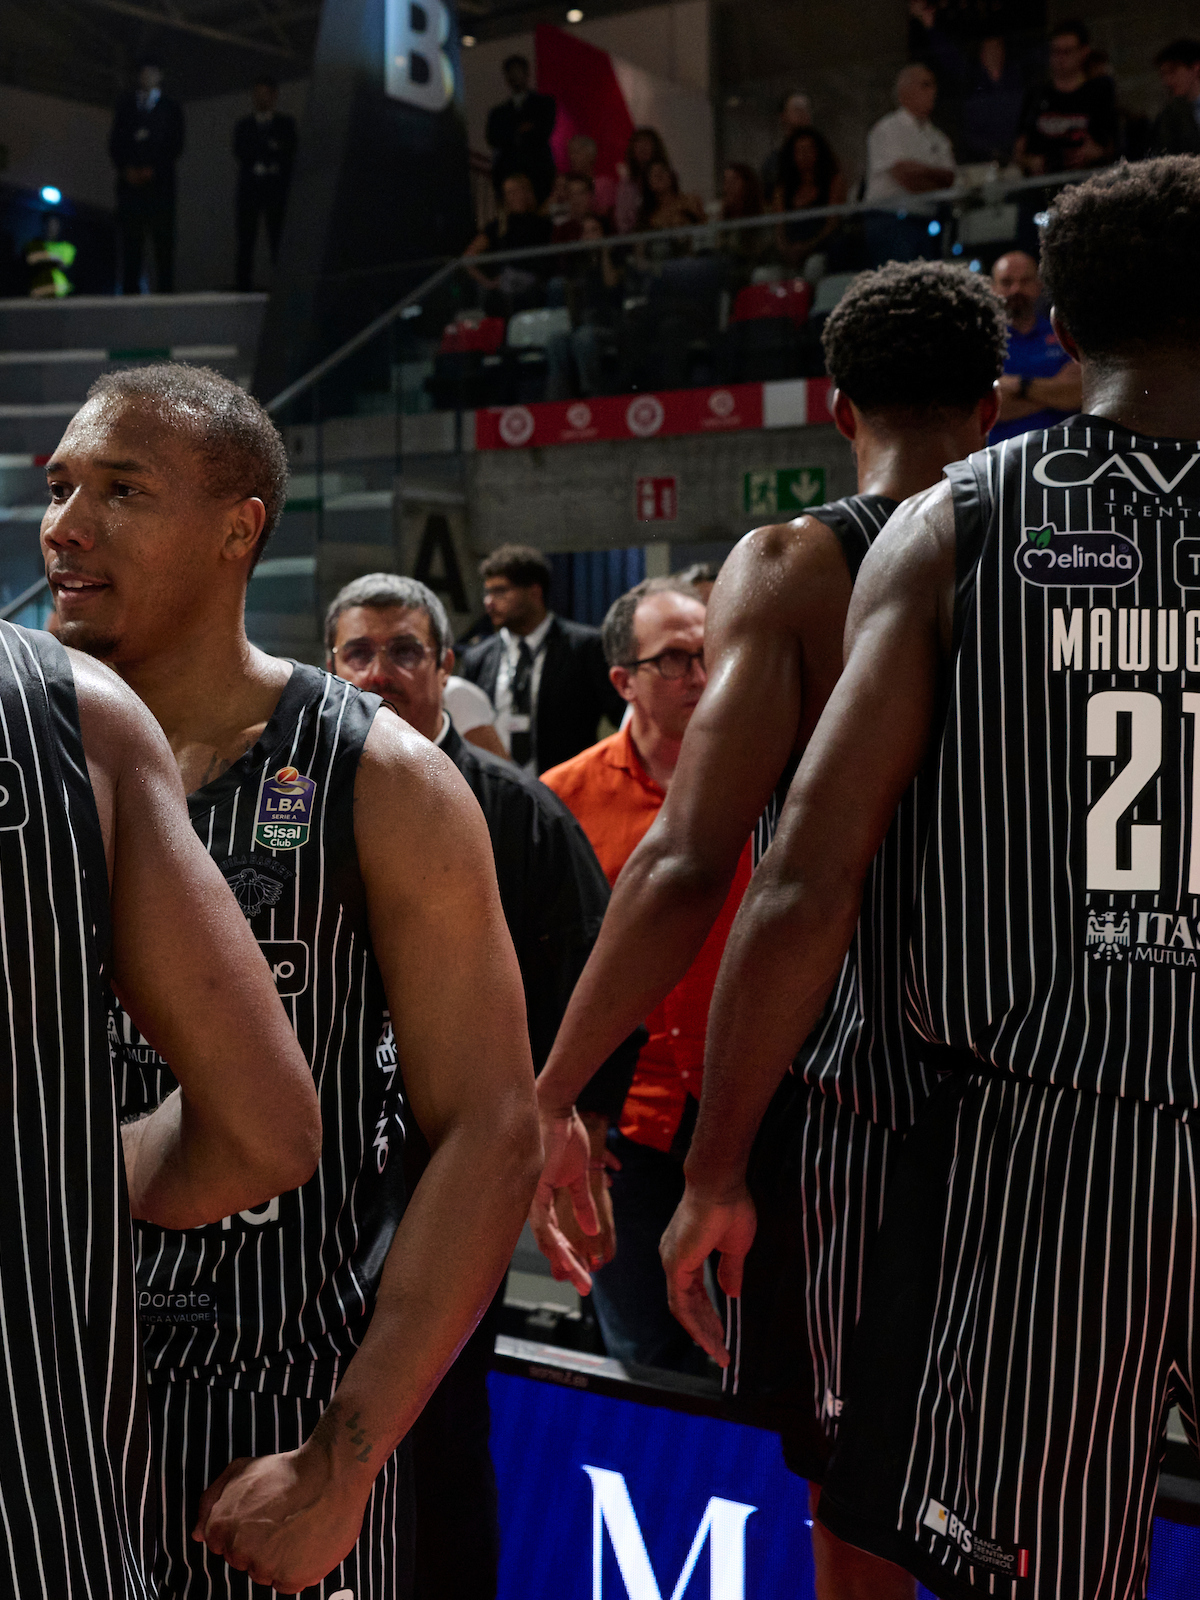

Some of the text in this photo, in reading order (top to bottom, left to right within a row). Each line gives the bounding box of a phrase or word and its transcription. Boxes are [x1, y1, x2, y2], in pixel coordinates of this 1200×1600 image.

[383, 0, 454, 111] B
[1104, 503, 1200, 519] TRENT
[413, 514, 469, 613] A
[1023, 543, 1133, 570] Melinda
[265, 798, 307, 813] LBA
[271, 813, 290, 821] SERIE
[263, 825, 301, 840] Sisal
[270, 839, 292, 848] Club
[1135, 911, 1200, 950] ITA
[1135, 946, 1198, 968] MUTUA
[123, 1046, 168, 1065] MUTU
[138, 1290, 211, 1310] porate
[173, 1312, 211, 1322] VALORE
[948, 1512, 973, 1553] BTS
